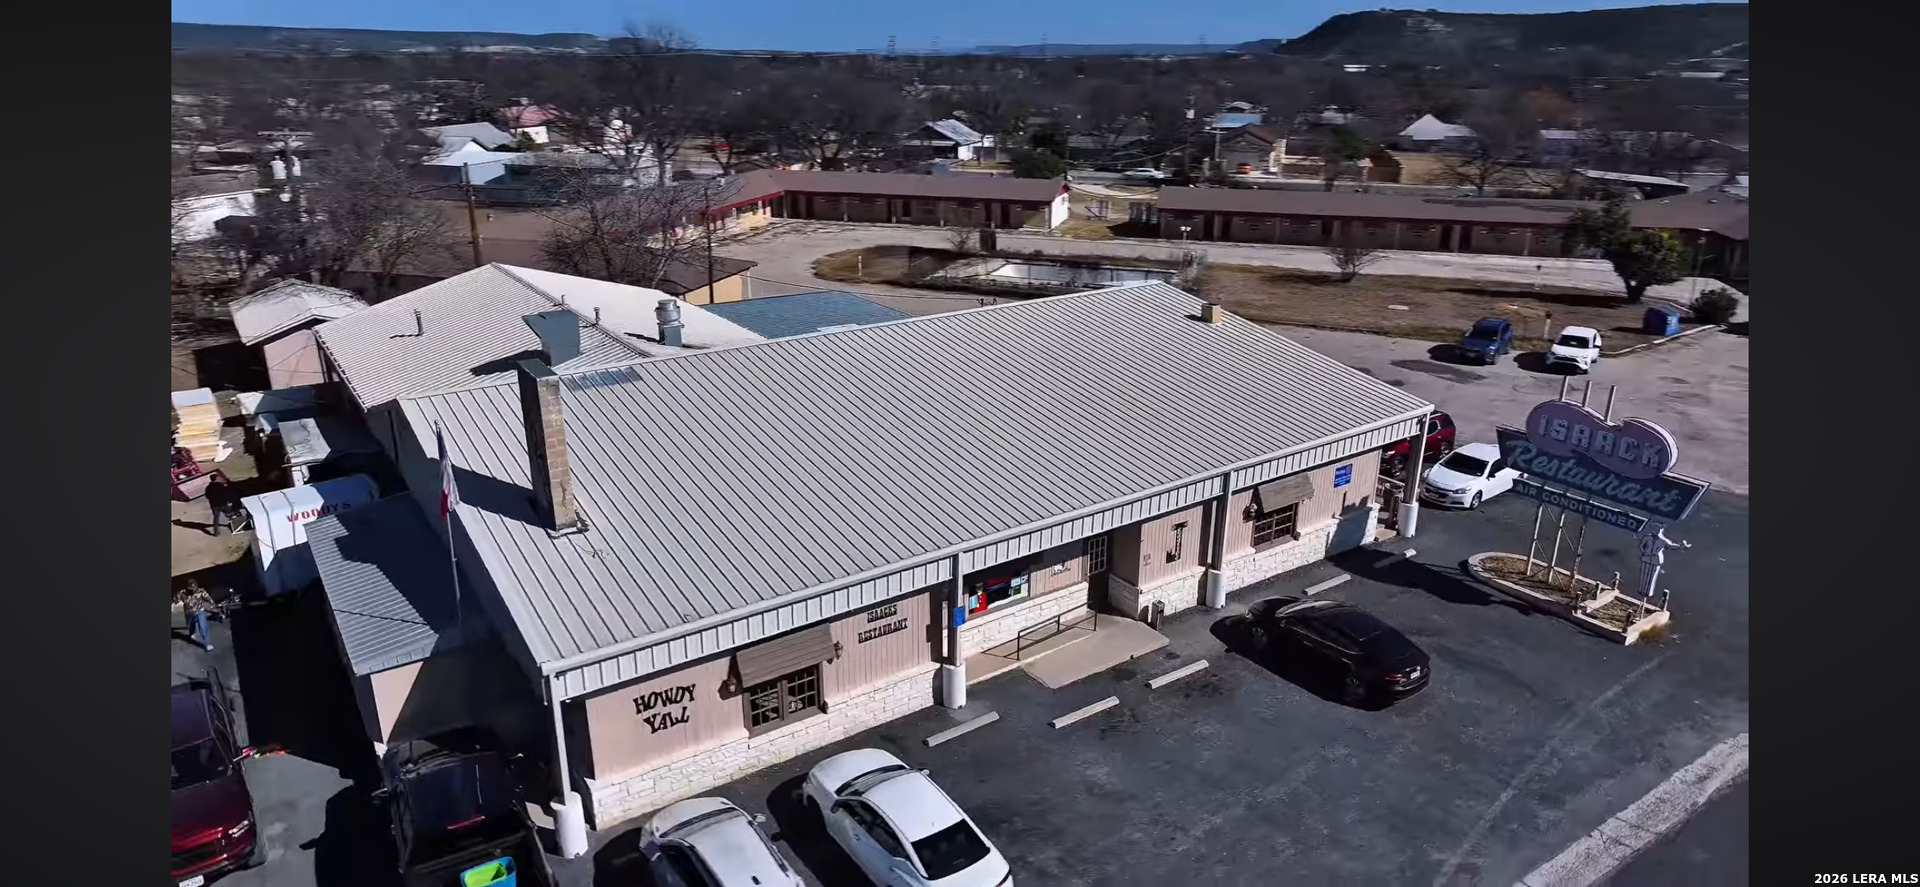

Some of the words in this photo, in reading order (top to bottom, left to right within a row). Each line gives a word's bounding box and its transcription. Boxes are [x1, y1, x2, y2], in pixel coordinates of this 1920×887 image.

[1538, 414, 1661, 468] ISAACK
[1505, 439, 1682, 512] Restaurant
[1516, 484, 1537, 496] AIR
[1542, 493, 1638, 528] CONDITIONED
[858, 617, 908, 644] RESTAURANT
[632, 683, 696, 715] HOWDY
